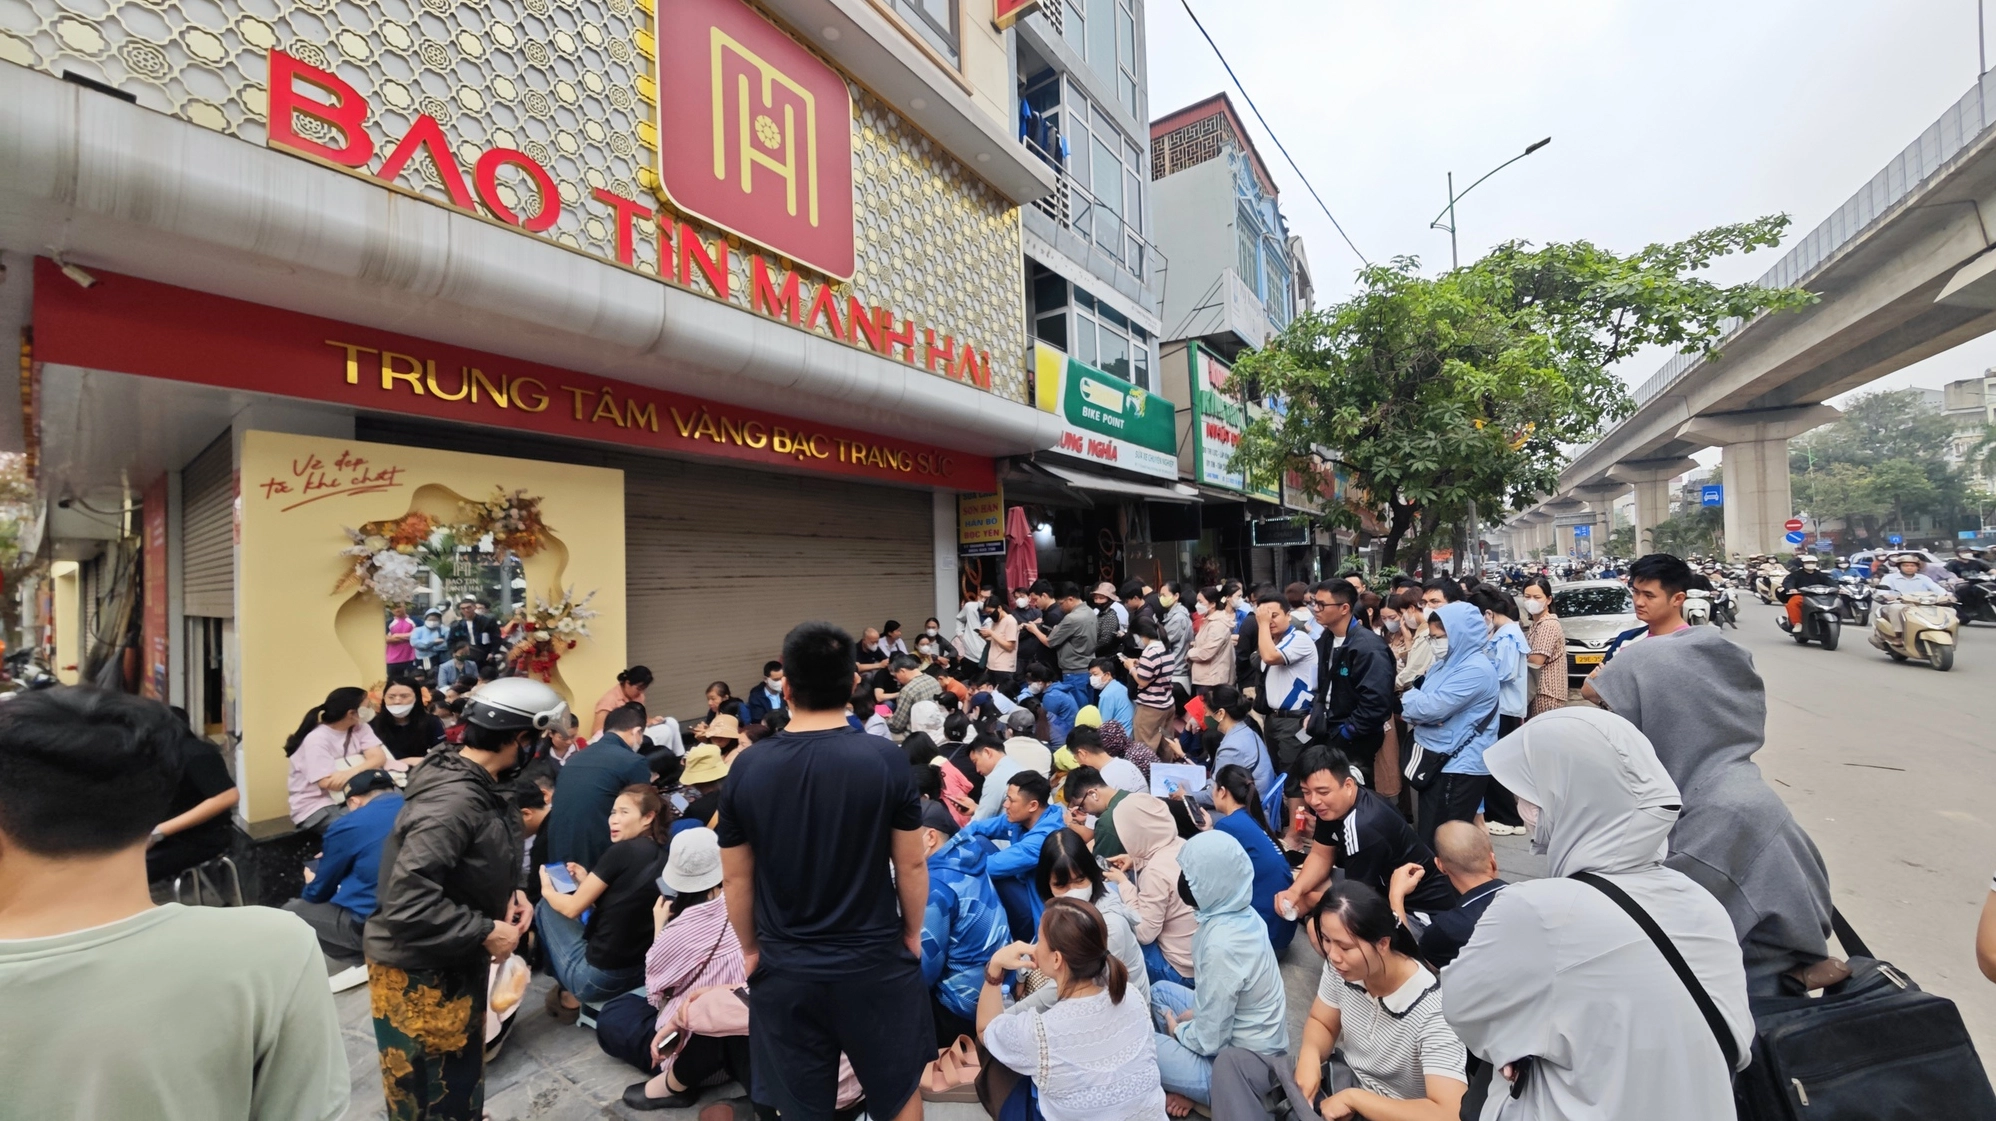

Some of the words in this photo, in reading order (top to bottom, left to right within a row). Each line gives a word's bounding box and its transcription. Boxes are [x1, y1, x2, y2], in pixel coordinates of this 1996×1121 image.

[324, 339, 550, 413] TRUNG
[560, 386, 660, 433] TÂM
[670, 405, 767, 449] VÀNG
[773, 426, 829, 460] BẠC
[834, 437, 912, 473] TRANG
[916, 450, 955, 478] SỨC
[1082, 406, 1101, 422] BIKE
[1102, 413, 1125, 429] POINT
[1056, 431, 1083, 454] UNG
